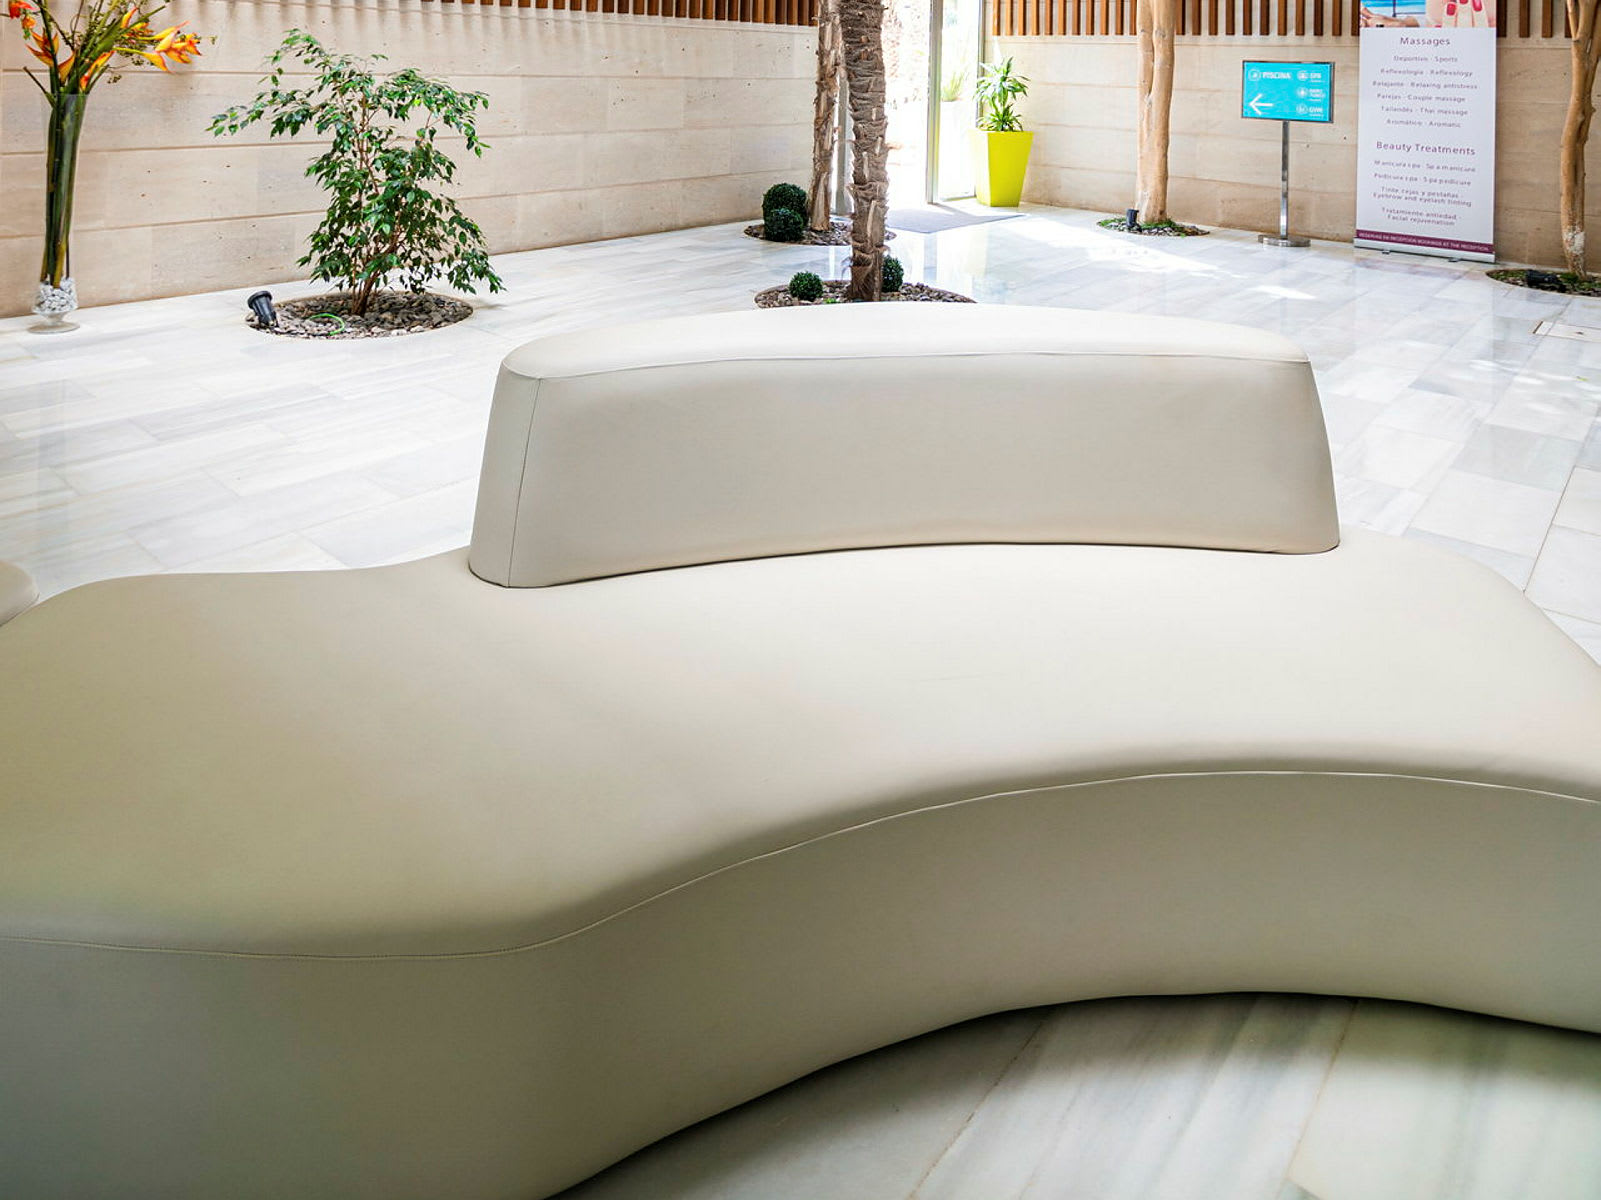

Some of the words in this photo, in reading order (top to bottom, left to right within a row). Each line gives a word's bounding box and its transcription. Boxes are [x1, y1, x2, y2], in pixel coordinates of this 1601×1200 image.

[1400, 37, 1451, 47] Massages
[1376, 141, 1411, 152] Beauty
[1415, 143, 1475, 156] Treatments
